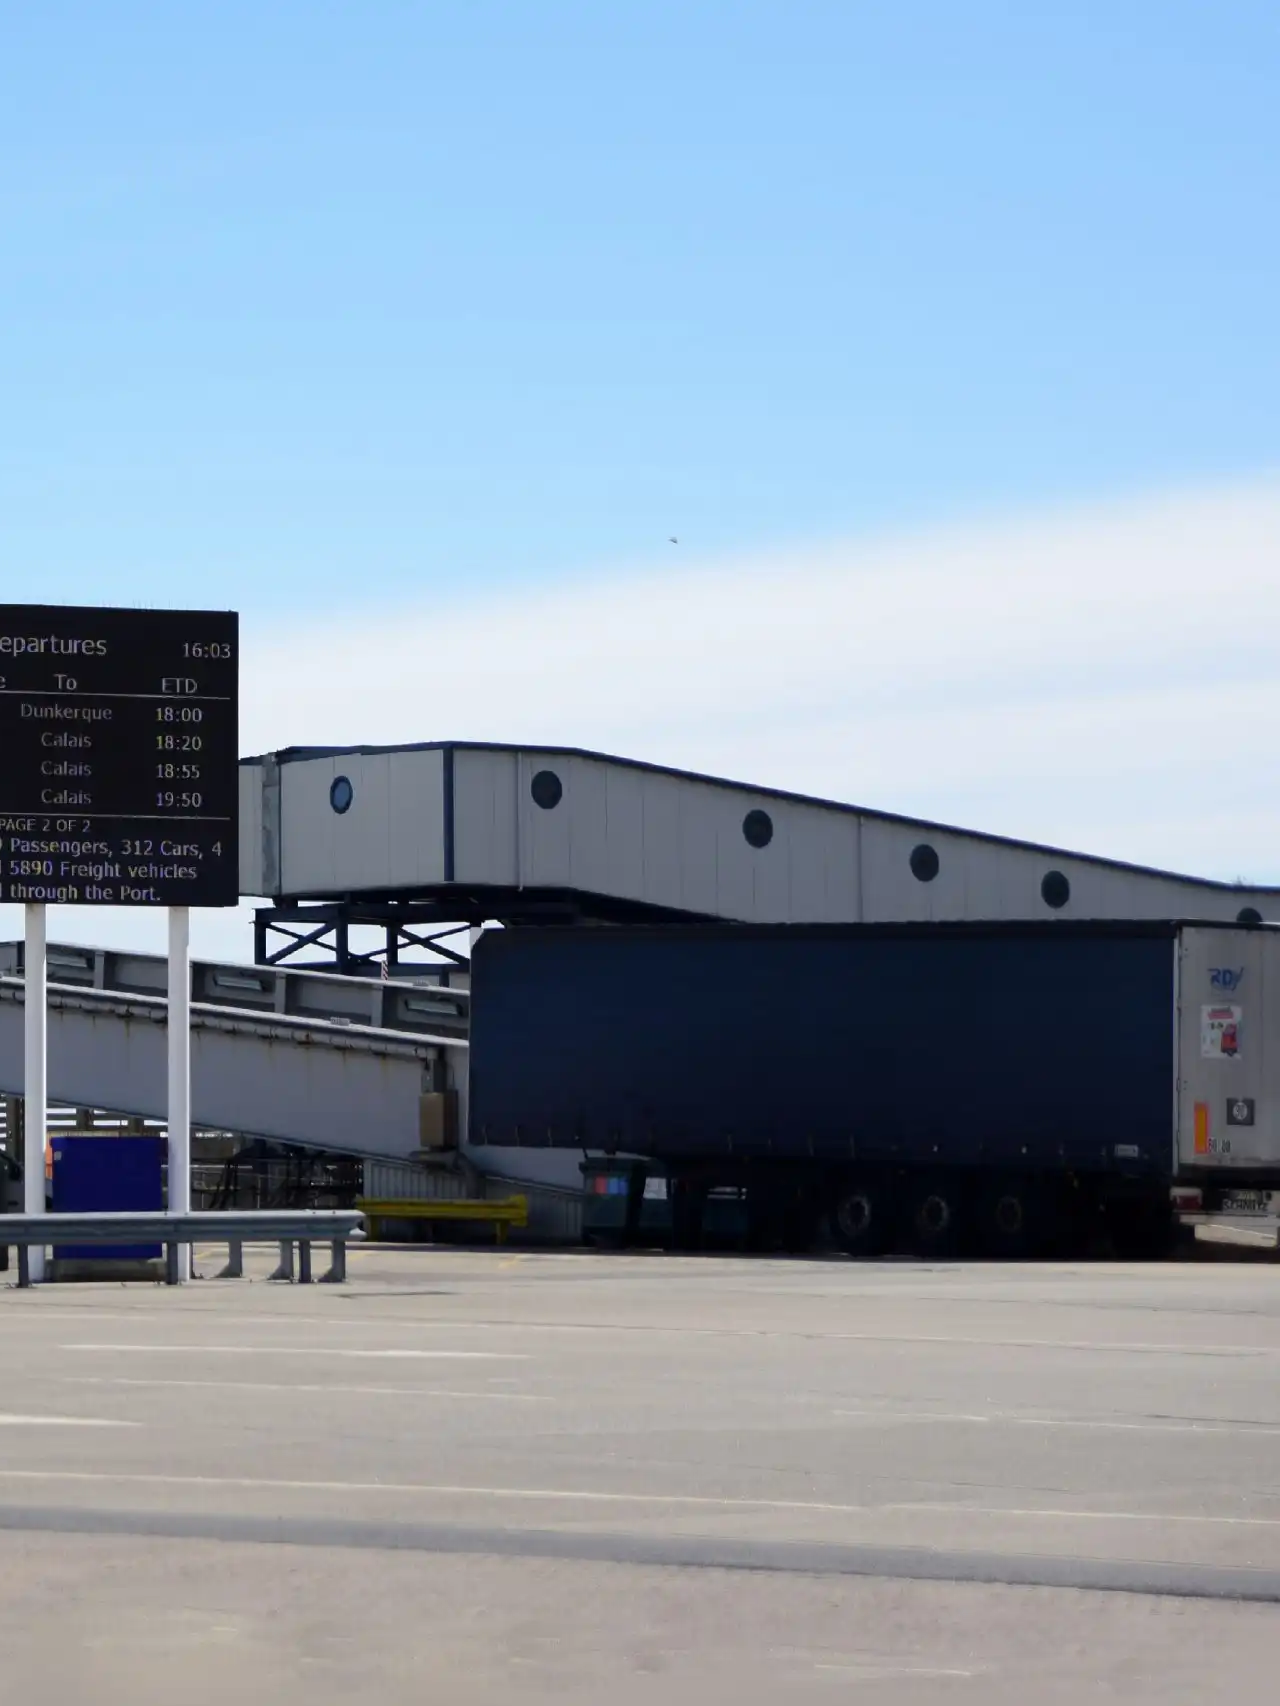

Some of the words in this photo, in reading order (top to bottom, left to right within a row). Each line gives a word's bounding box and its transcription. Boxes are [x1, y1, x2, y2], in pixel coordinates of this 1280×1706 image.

[183, 643, 231, 659] 16:03
[54, 674, 77, 691] To
[162, 678, 198, 695] ETD
[21, 703, 112, 721] Dunkerque
[156, 707, 202, 723] 18:00
[41, 732, 92, 749] Calais
[156, 735, 202, 751] 18:20
[41, 760, 92, 777] Calais
[156, 764, 200, 779] 18:55
[41, 789, 92, 805] Calais
[156, 792, 202, 808] 19:50
[42, 819, 50, 832] 2
[57, 819, 76, 832] OF
[82, 820, 91, 833] 2
[10, 838, 113, 858] Passengers,
[121, 840, 153, 856] 312
[160, 841, 203, 859] Cars,
[212, 842, 222, 857] 4
[9, 860, 53, 876] 5890
[61, 861, 121, 879] Freight
[129, 863, 197, 880] vehicles
[10, 883, 78, 902] through
[85, 884, 113, 900] the
[121, 885, 161, 901] Port.
